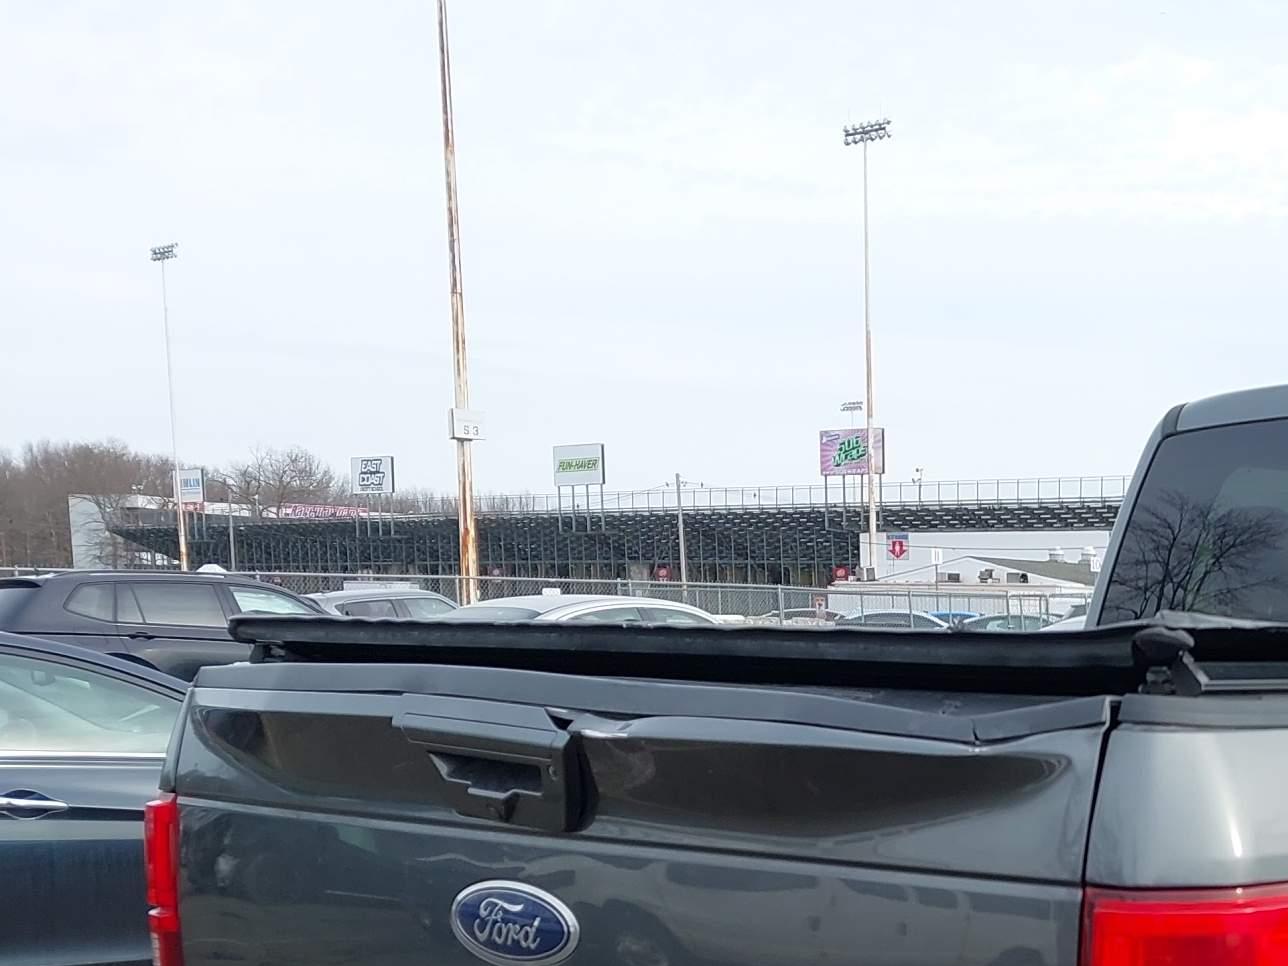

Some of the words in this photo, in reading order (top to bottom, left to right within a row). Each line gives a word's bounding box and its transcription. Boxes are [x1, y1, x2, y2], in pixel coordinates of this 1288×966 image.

[360, 459, 383, 472] EAST
[359, 472, 385, 486] COAST
[473, 898, 541, 950] Ford
